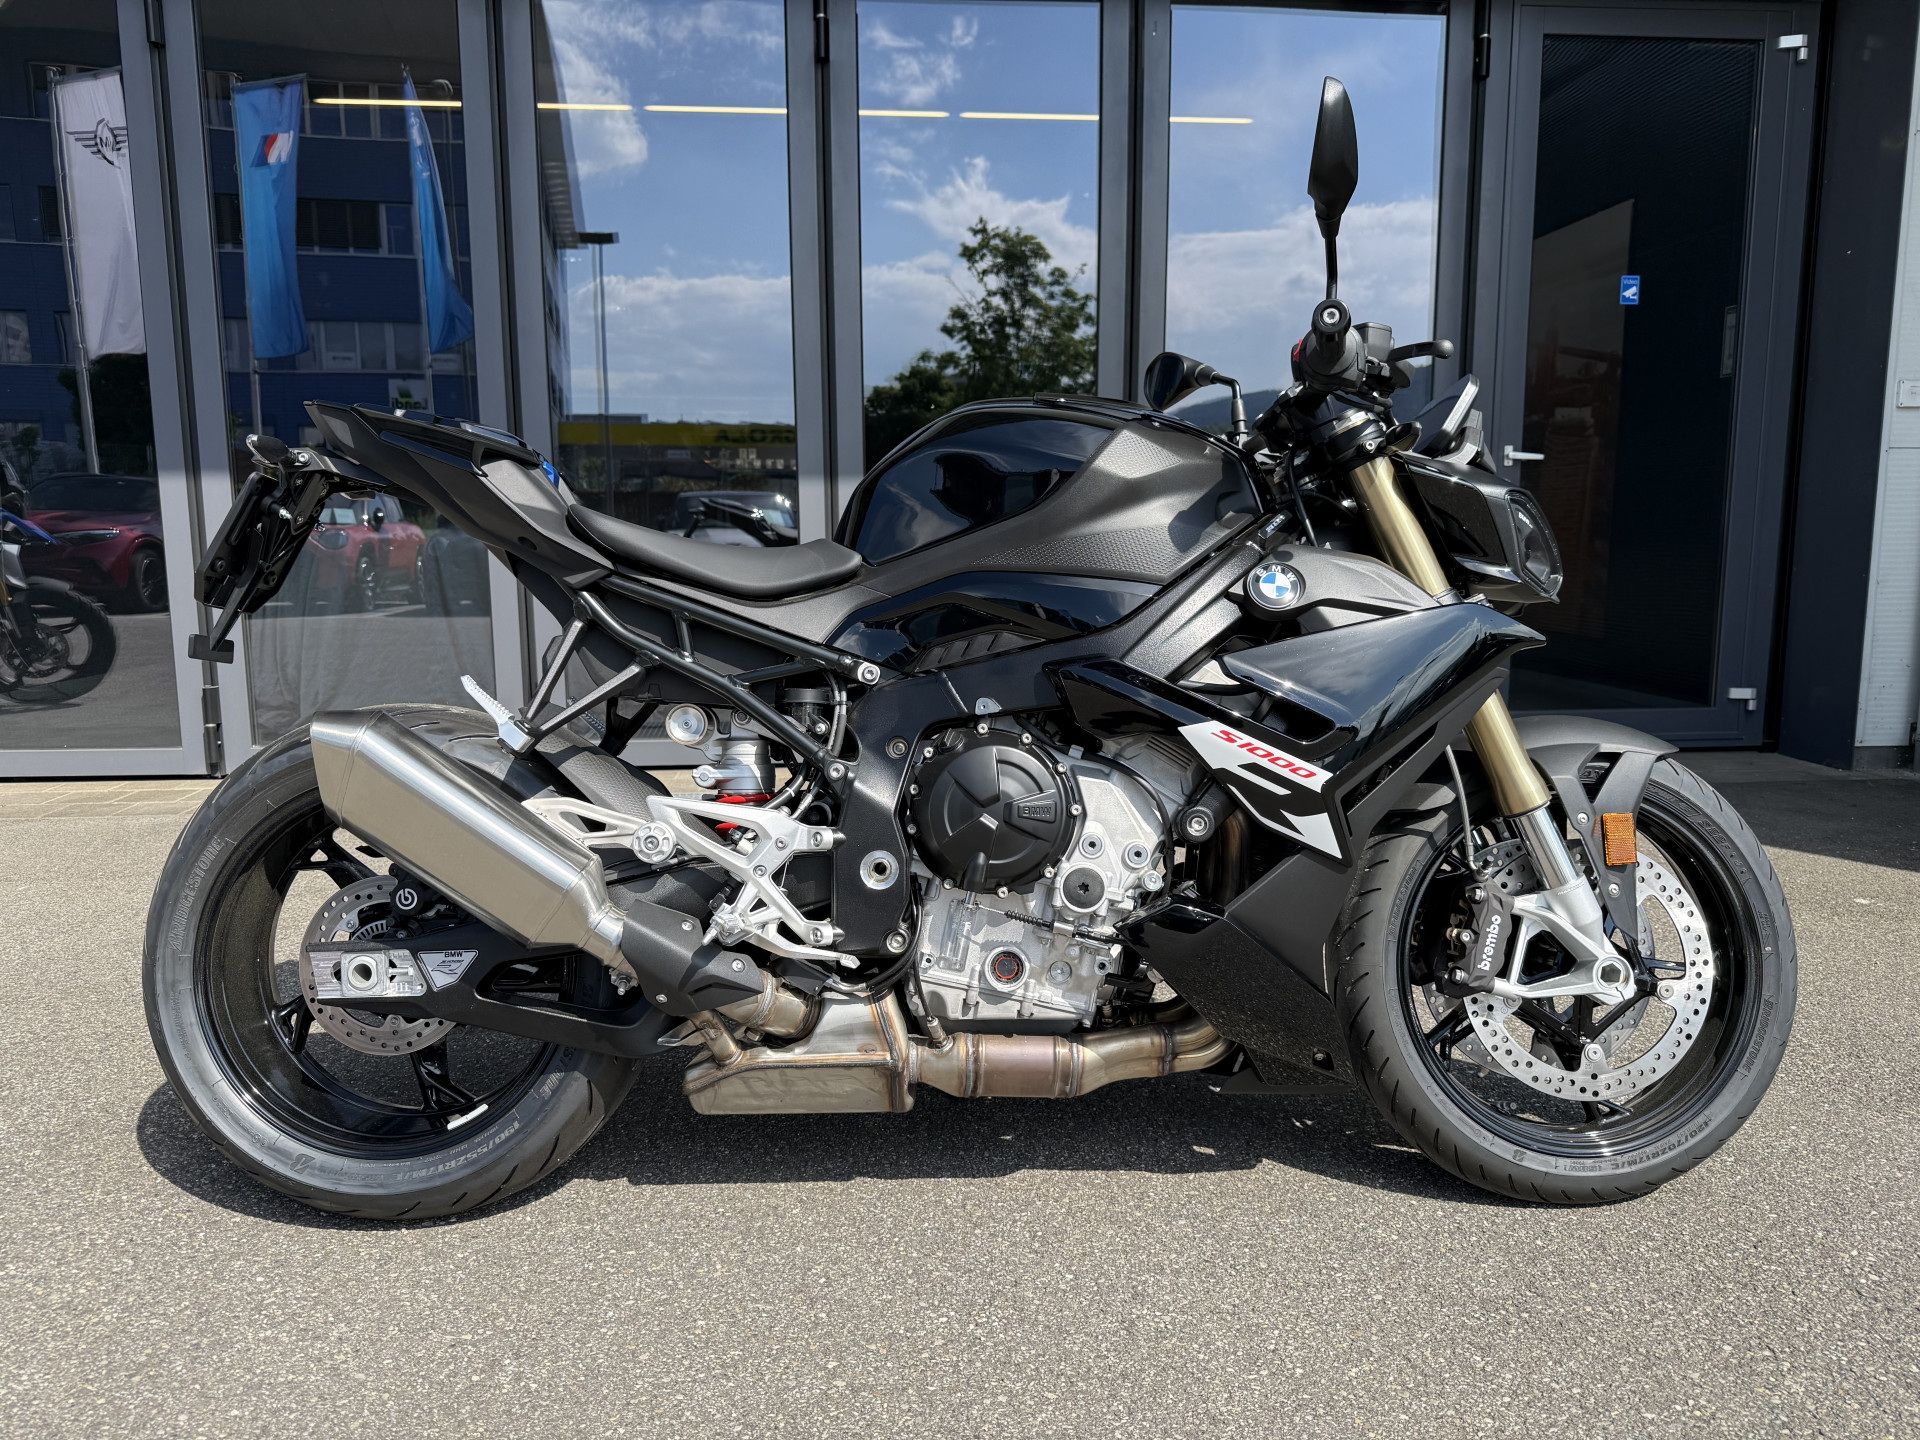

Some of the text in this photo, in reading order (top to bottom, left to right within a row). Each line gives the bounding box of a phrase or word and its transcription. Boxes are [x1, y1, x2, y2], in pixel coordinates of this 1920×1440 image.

[1256, 565, 1298, 582] BMW
[1211, 730, 1317, 779] S1000
[1022, 806, 1052, 817] BMW
[167, 835, 225, 952] BRIDGESTONE
[1477, 914, 1502, 971] brembo
[1742, 998, 1774, 1074] BRIDGESTONE
